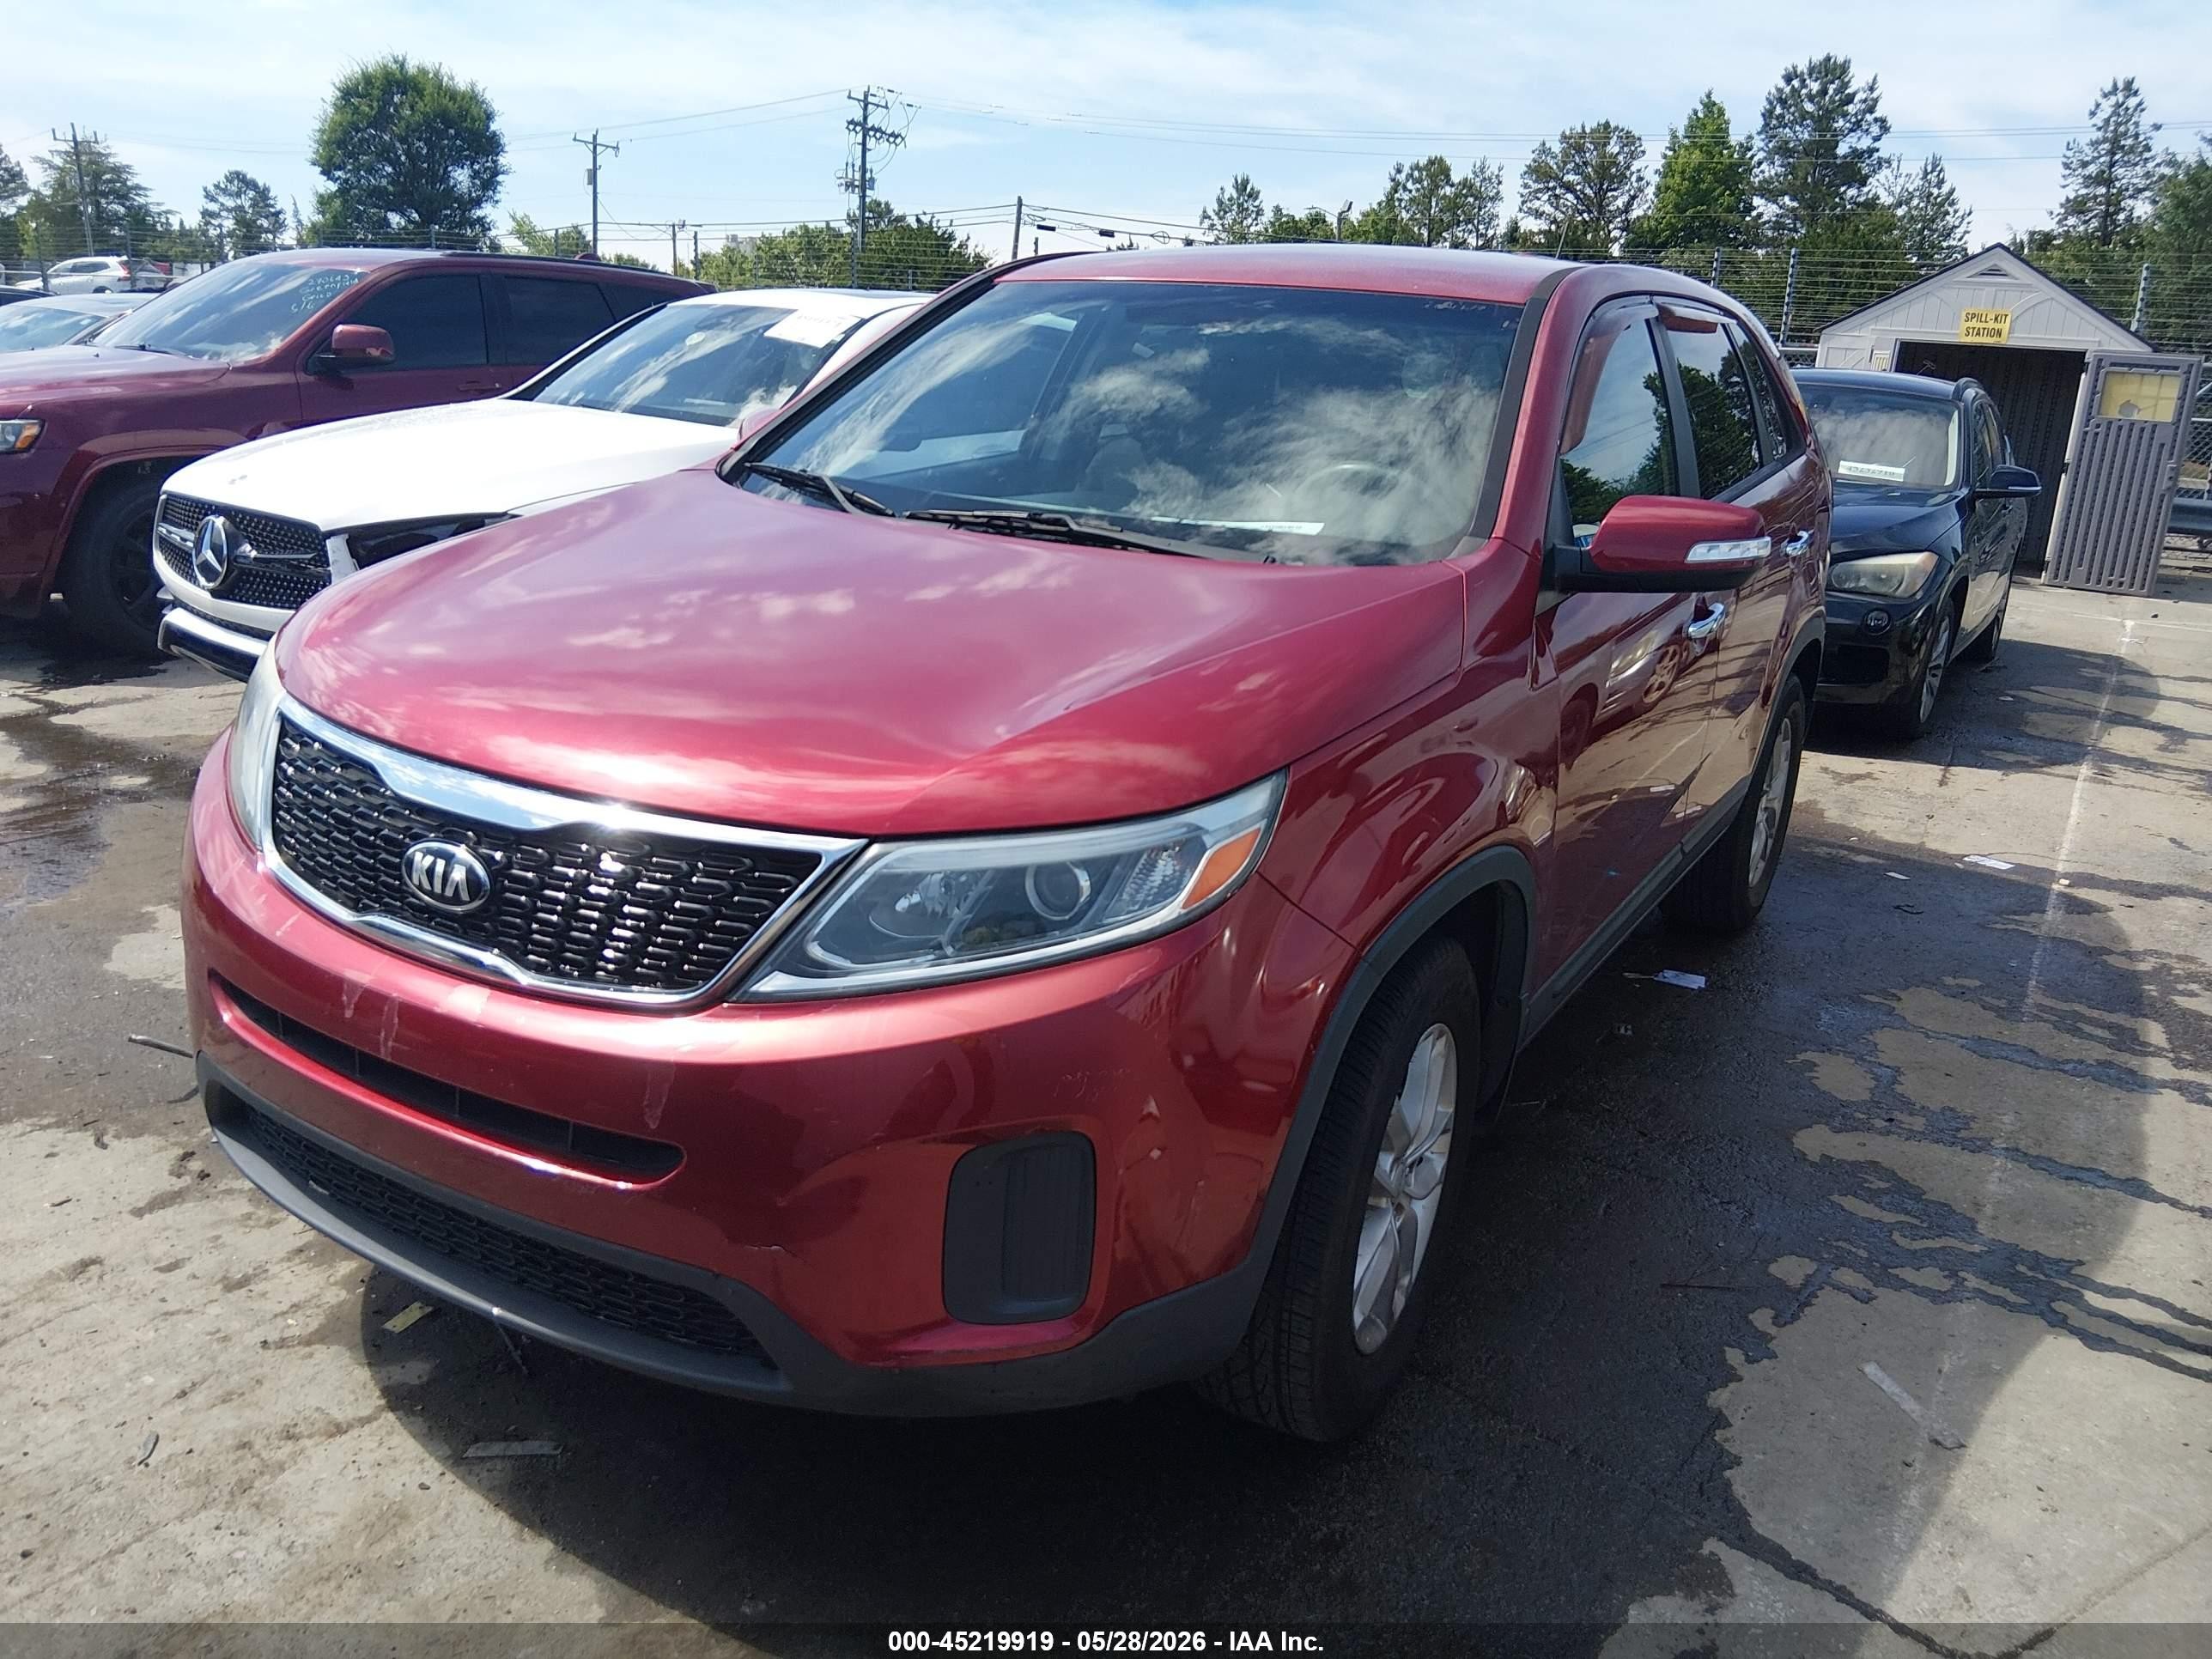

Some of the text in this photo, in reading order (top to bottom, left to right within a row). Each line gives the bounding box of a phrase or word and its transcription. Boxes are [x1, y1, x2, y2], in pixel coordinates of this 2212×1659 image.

[1964, 312, 2009, 325] SPILL-KIT
[1964, 326, 2003, 339] STATION
[411, 850, 471, 902] KIA
